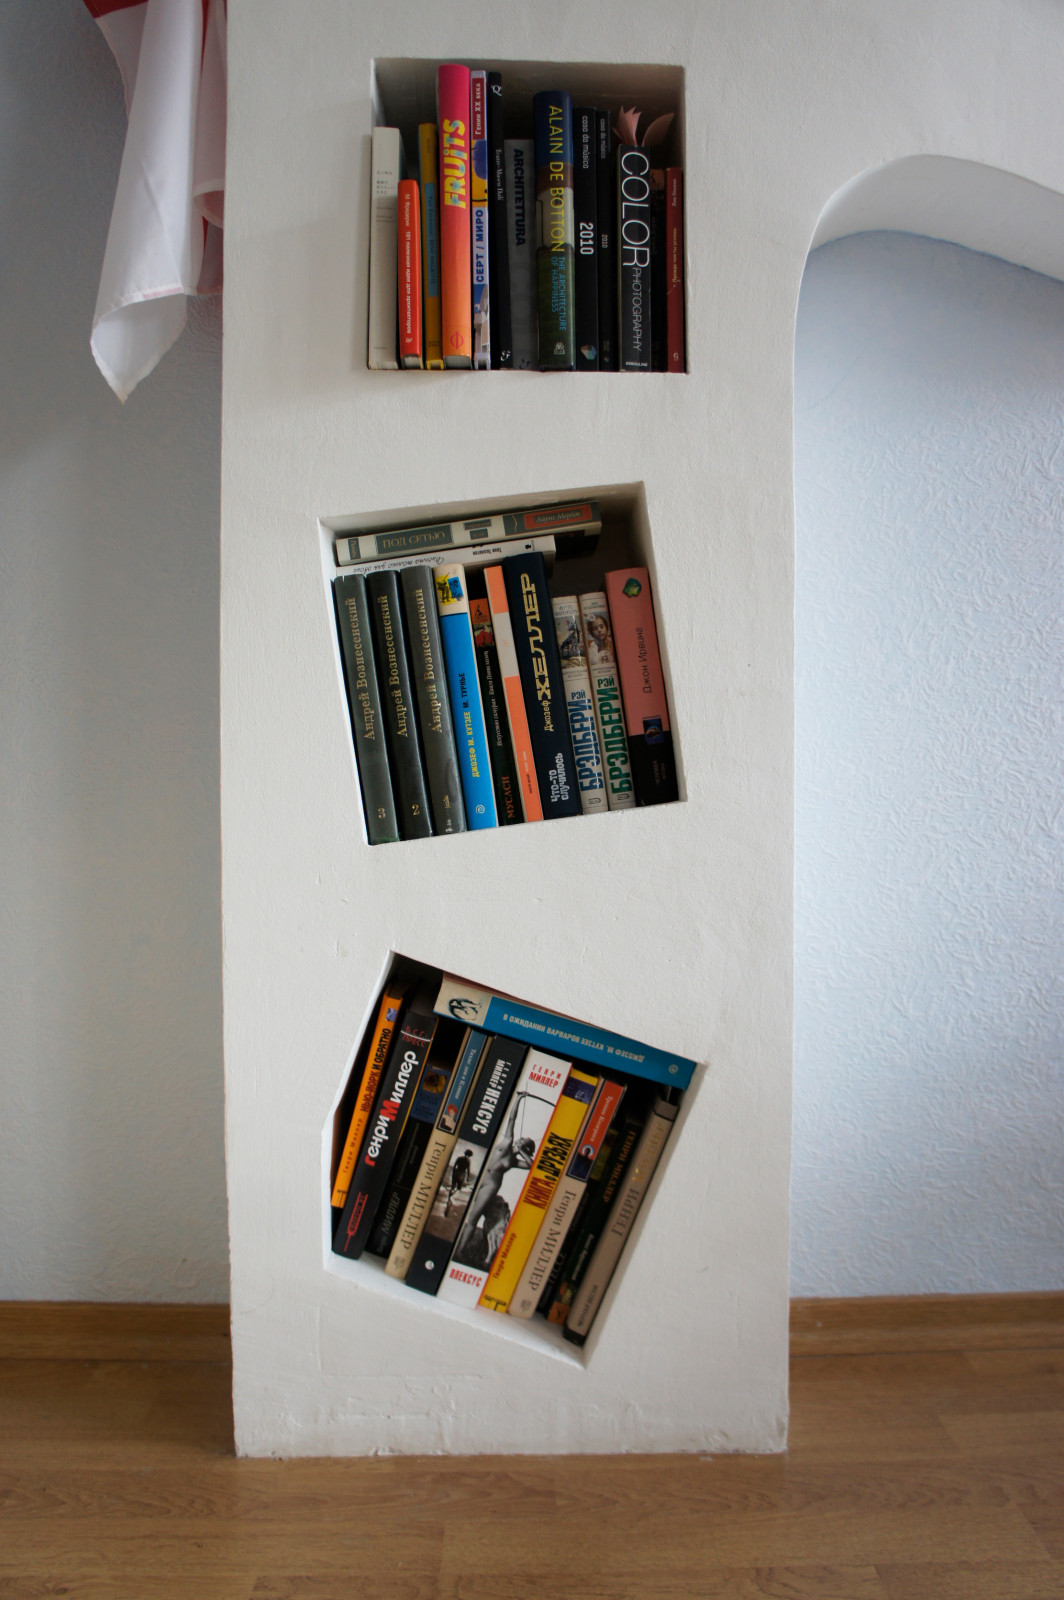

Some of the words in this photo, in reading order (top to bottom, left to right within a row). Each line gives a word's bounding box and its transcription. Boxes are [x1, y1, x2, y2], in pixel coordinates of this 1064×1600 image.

[549, 105, 563, 154] ALAIN
[582, 134, 588, 142] da
[550, 162, 564, 180] DE
[514, 149, 526, 246] ARCHITETTURA
[621, 152, 650, 267] COLOR
[476, 210, 484, 241] МИРО
[550, 188, 564, 252] BOTTON
[580, 223, 594, 255] 2010
[476, 254, 484, 282] СЕРТ
[552, 257, 558, 266] OF
[632, 268, 642, 351] PHOTOGRAPHY
[409, 531, 445, 543] СЕТЬЮ
[345, 597, 368, 690] Вознесенский
[377, 595, 400, 687] Вознесенский
[413, 588, 435, 682] Вознесенский
[636, 627, 648, 659] Ирвинг
[458, 673, 468, 697] ТУРНЬЕ
[597, 675, 615, 687] РЭЙ
[639, 662, 652, 694] Джон
[426, 684, 442, 733] Андрей
[463, 697, 469, 708] М.
[571, 690, 586, 700] РЭЙ
[358, 692, 376, 740] Андрей
[393, 688, 408, 737] Андрей
[464, 712, 472, 735] КУТЗЕЕ
[541, 700, 554, 732] Джозеф
[468, 736, 475, 746] М.
[567, 698, 604, 791] БРЭДБЕРИ
[598, 686, 633, 794] БРЭДБЕРИ
[468, 747, 480, 777] ДЖОЗЕФ
[555, 752, 569, 800] случилось
[502, 776, 515, 818] МУСАСИ
[549, 770, 558, 803] Что-то
[378, 808, 386, 819] 3
[412, 804, 420, 816] 2
[509, 1015, 545, 1032] ОЖИДАНИИ
[547, 1027, 580, 1043] ВАРВАРОВ
[581, 1038, 604, 1050] КУТЗЕЕ
[360, 1069, 379, 1112] НЬЮ-ЙОРК
[374, 1028, 391, 1064] ОБРАТНО
[615, 1048, 645, 1063] ДЖОЗЕФ
[489, 1058, 505, 1089] МИЛЛЕР
[528, 1072, 559, 1088] МИЛЛЕР
[533, 1064, 562, 1080] ГЕНРИ
[472, 1088, 500, 1134] НЕКСУС
[424, 1141, 446, 1181] Генри
[537, 1132, 573, 1177] ДРУЗЬЯХ
[524, 1177, 555, 1210] КНИГА
[552, 1190, 577, 1226] Генри
[401, 1183, 429, 1249] МИЛЛЕР
[612, 1188, 640, 1236] ГЕНРИ
[529, 1228, 560, 1291] МИЛЛЕР
[449, 1268, 482, 1287] ПЛЕКСУС
